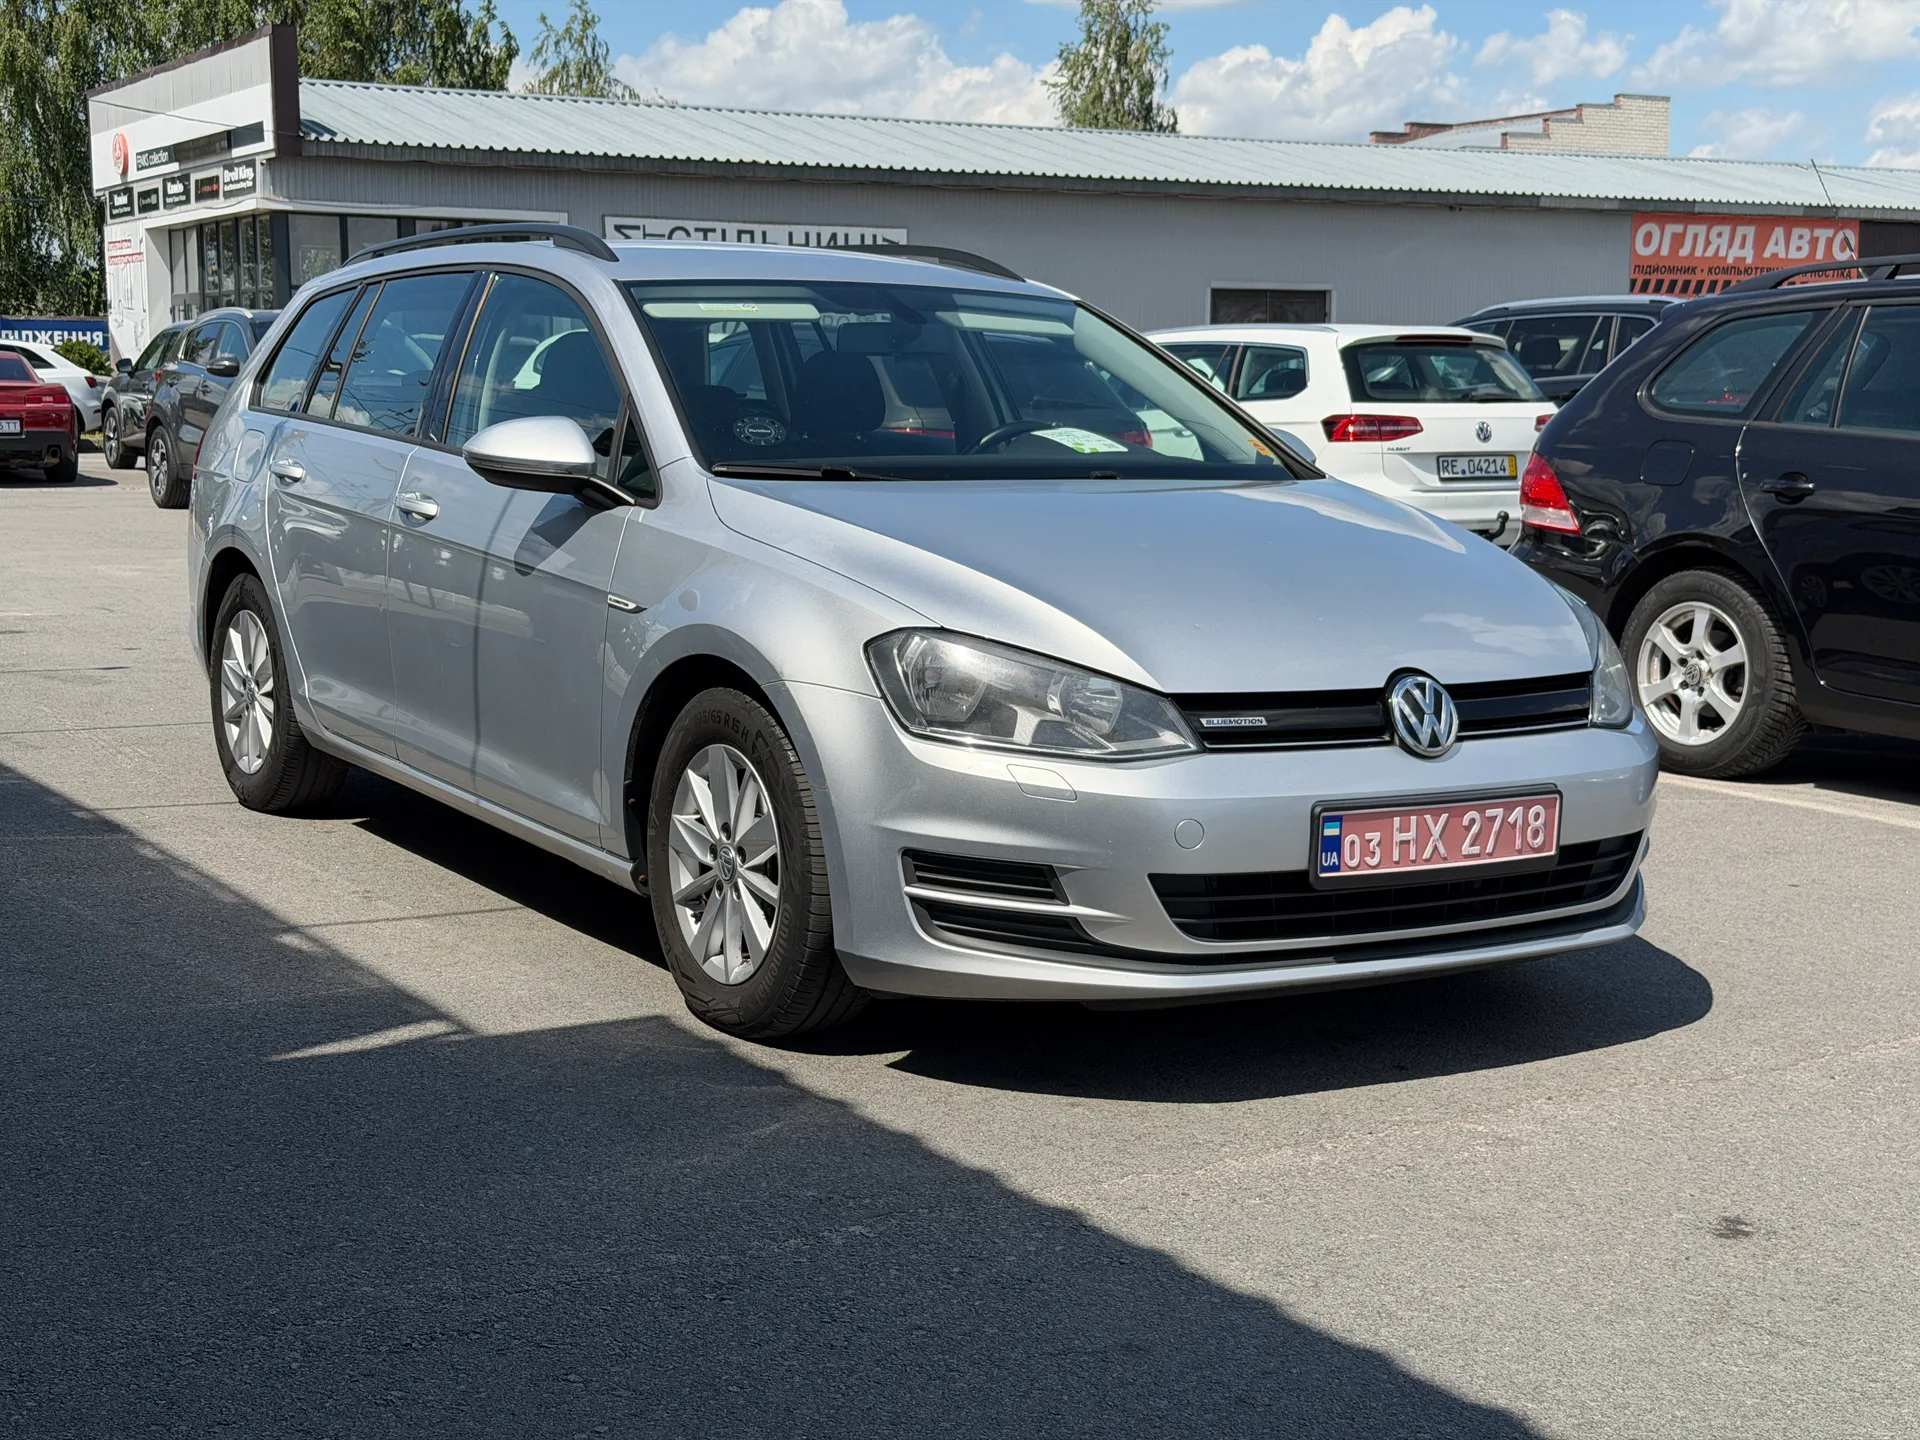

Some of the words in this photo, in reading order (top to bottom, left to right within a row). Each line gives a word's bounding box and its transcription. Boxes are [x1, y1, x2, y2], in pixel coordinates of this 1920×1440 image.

[1634, 222, 1756, 264] ОГЛЯД
[1763, 226, 1856, 262] АВТО
[1633, 263, 1697, 276] ПІДЙОМНИК
[1441, 459, 1460, 475] RE
[1467, 458, 1506, 475] 04214
[1205, 718, 1264, 726] BLUEMOTION
[1344, 832, 1381, 868] 03
[1392, 813, 1449, 863] HX
[1461, 804, 1546, 856] 2718
[1322, 852, 1339, 866] UA
